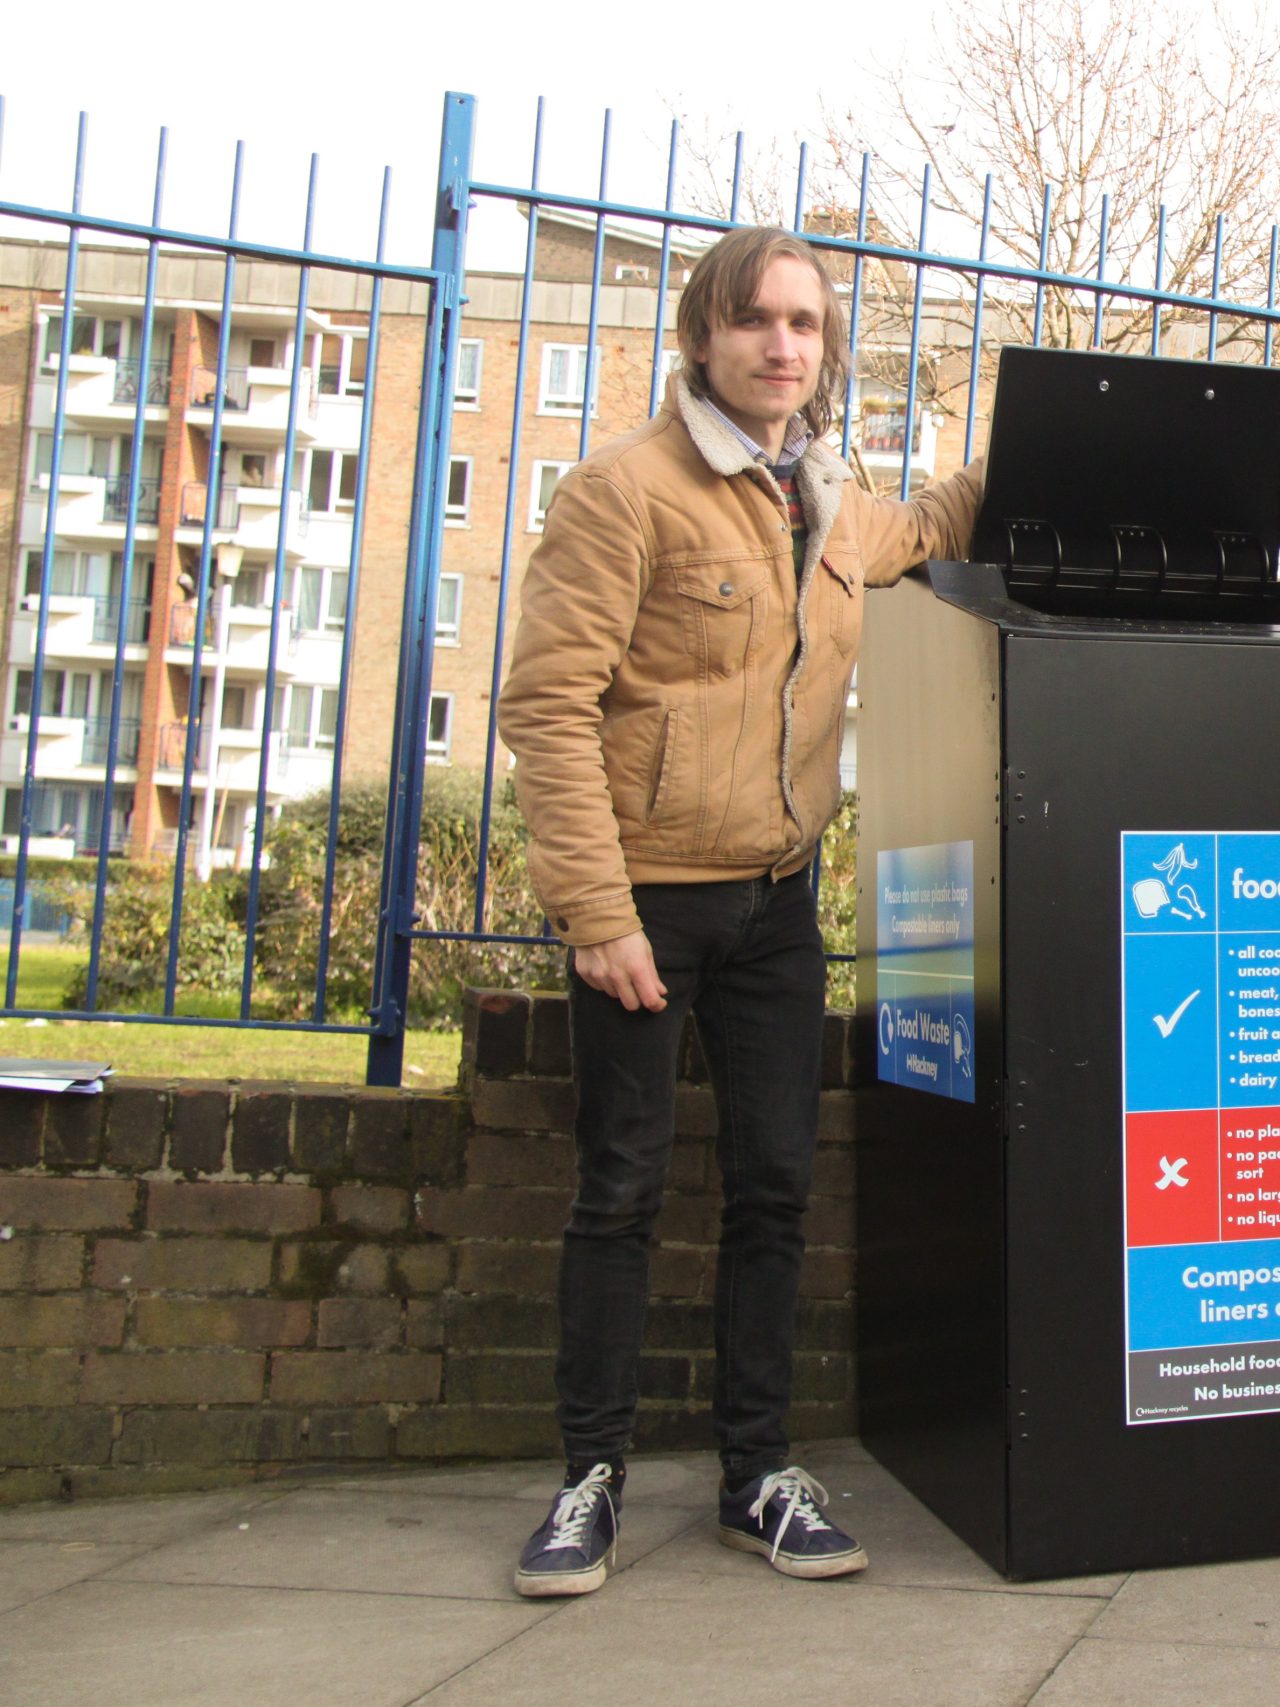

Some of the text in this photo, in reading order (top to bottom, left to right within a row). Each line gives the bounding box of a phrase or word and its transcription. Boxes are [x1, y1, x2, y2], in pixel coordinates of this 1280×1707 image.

[884, 885, 901, 904] Please
[903, 884, 909, 904] do
[931, 881, 950, 908] plastic
[951, 881, 968, 907] bags
[892, 913, 927, 938] Compostable
[946, 912, 960, 940] only
[1238, 946, 1256, 959] all
[1239, 987, 1279, 1001] meat,
[1238, 1005, 1280, 1018] bones
[896, 1009, 950, 1046] Food Waste
[1238, 1027, 1268, 1041] fruit
[1239, 1073, 1277, 1088] dairy
[1236, 1128, 1254, 1138] no
[1236, 1151, 1254, 1161] no
[1236, 1167, 1264, 1179] sort
[1237, 1192, 1255, 1202] no
[1237, 1214, 1255, 1225] no
[1201, 1300, 1268, 1323] liners
[1160, 1356, 1246, 1377] Household
[1194, 1387, 1218, 1401] No
